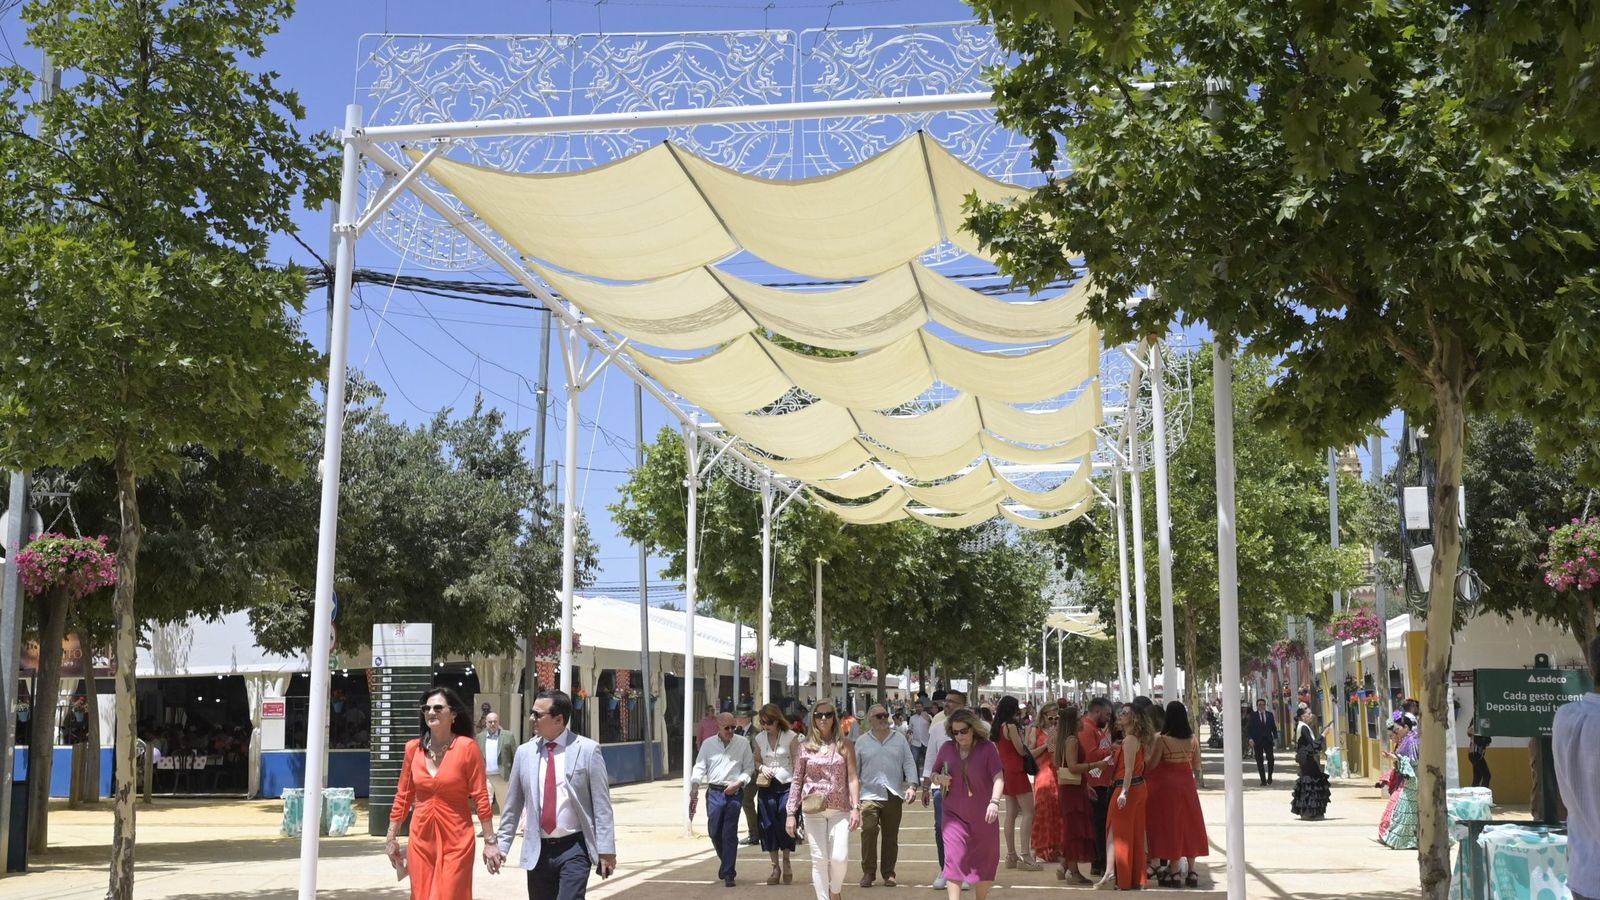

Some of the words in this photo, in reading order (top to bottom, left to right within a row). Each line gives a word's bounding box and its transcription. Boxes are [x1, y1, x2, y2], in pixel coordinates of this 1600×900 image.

[1536, 675, 1567, 684] sadeco
[1503, 691, 1527, 700] Cada
[1529, 693, 1555, 702] gesto
[1556, 694, 1583, 702] cuent
[1486, 702, 1528, 712] Deposita
[1529, 703, 1551, 714] aquí
